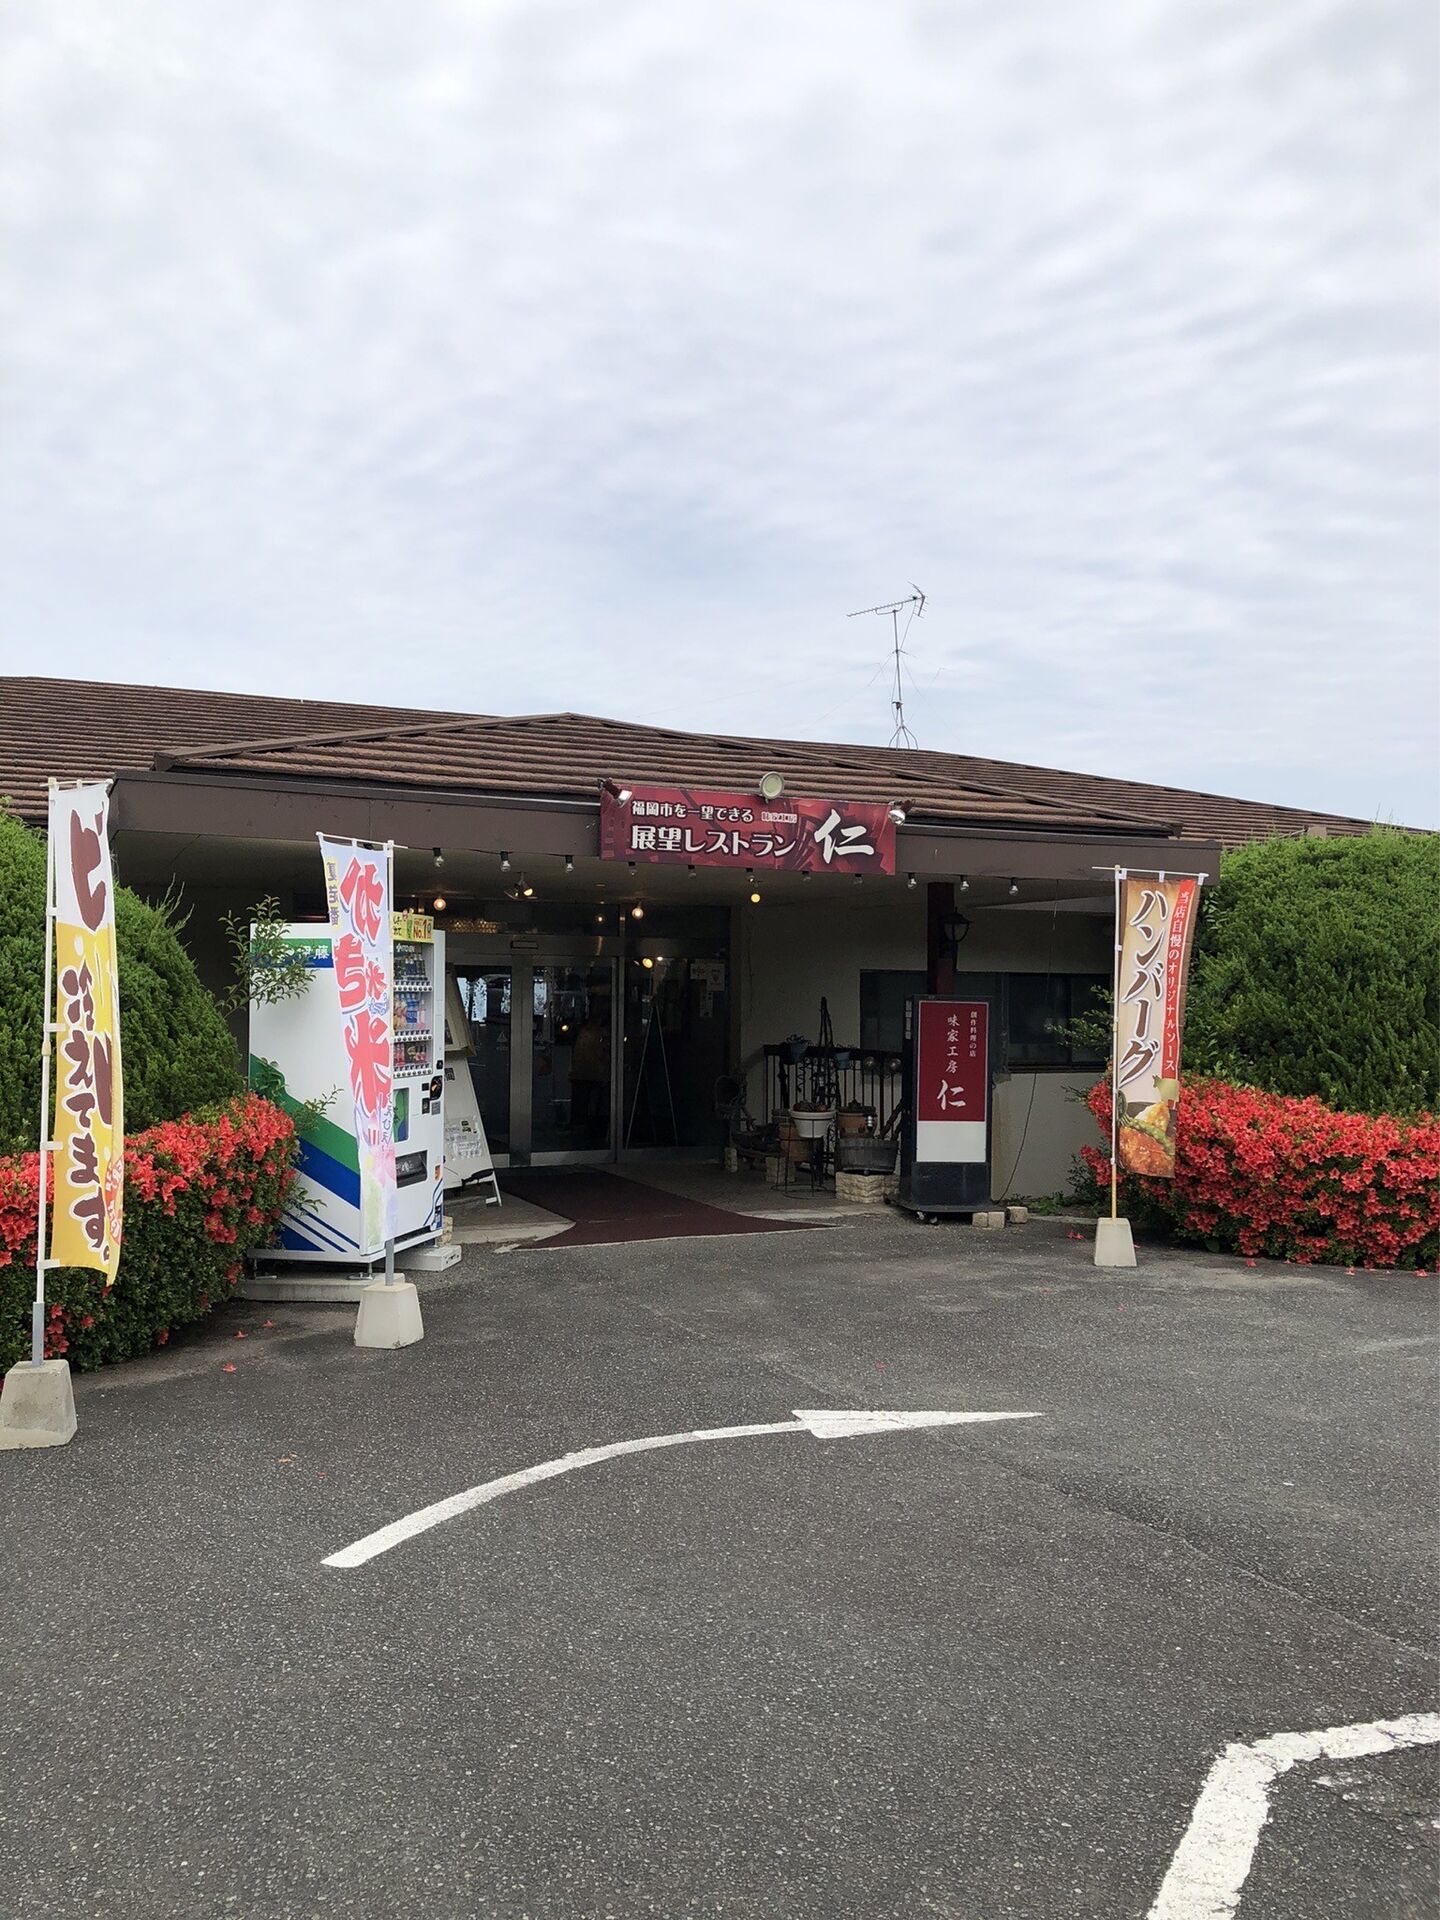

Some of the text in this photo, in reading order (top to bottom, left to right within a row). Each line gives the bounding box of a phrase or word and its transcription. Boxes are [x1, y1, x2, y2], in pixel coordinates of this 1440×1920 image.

[631, 800, 754, 823] 福岡市を一望できる
[813, 808, 875, 865] 仁
[631, 824, 797, 857] 展望レストラン
[1118, 889, 1168, 1087] ハンバーグ
[1165, 890, 1190, 1071] 当店自慢のオリジナルソース
[945, 1013, 961, 1074] 味家工房
[968, 1010, 979, 1058] 創作料理の店
[936, 1079, 967, 1111] 仁
